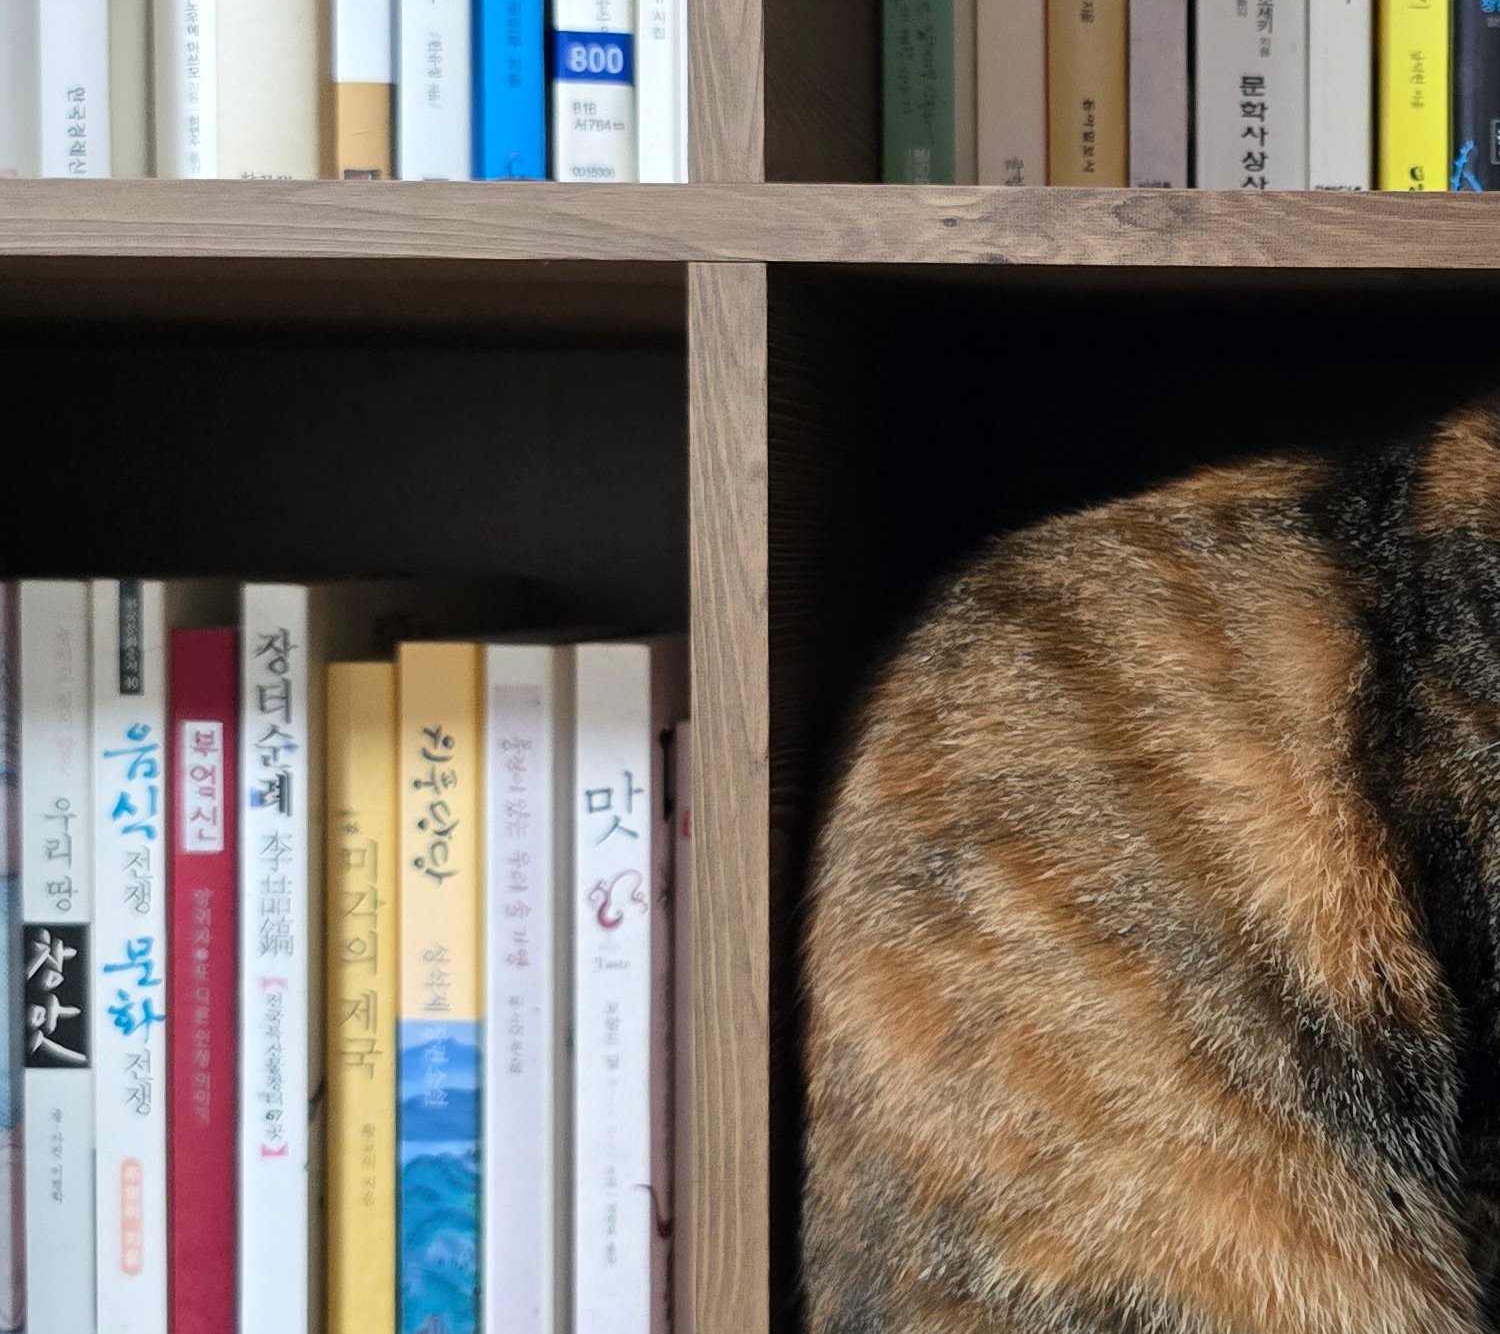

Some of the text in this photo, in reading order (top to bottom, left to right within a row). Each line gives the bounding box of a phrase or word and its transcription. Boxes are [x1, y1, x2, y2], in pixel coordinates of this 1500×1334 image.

[569, 44, 624, 75] 800
[103, 723, 165, 841] 음식
[584, 770, 642, 845] 맛
[42, 798, 74, 864] 우리
[43, 879, 79, 913] 땅
[120, 846, 153, 916] 전쟁
[339, 839, 386, 1082] 미각의 제국
[24, 928, 88, 1065] 참맛
[123, 1049, 153, 1116] 전쟁
